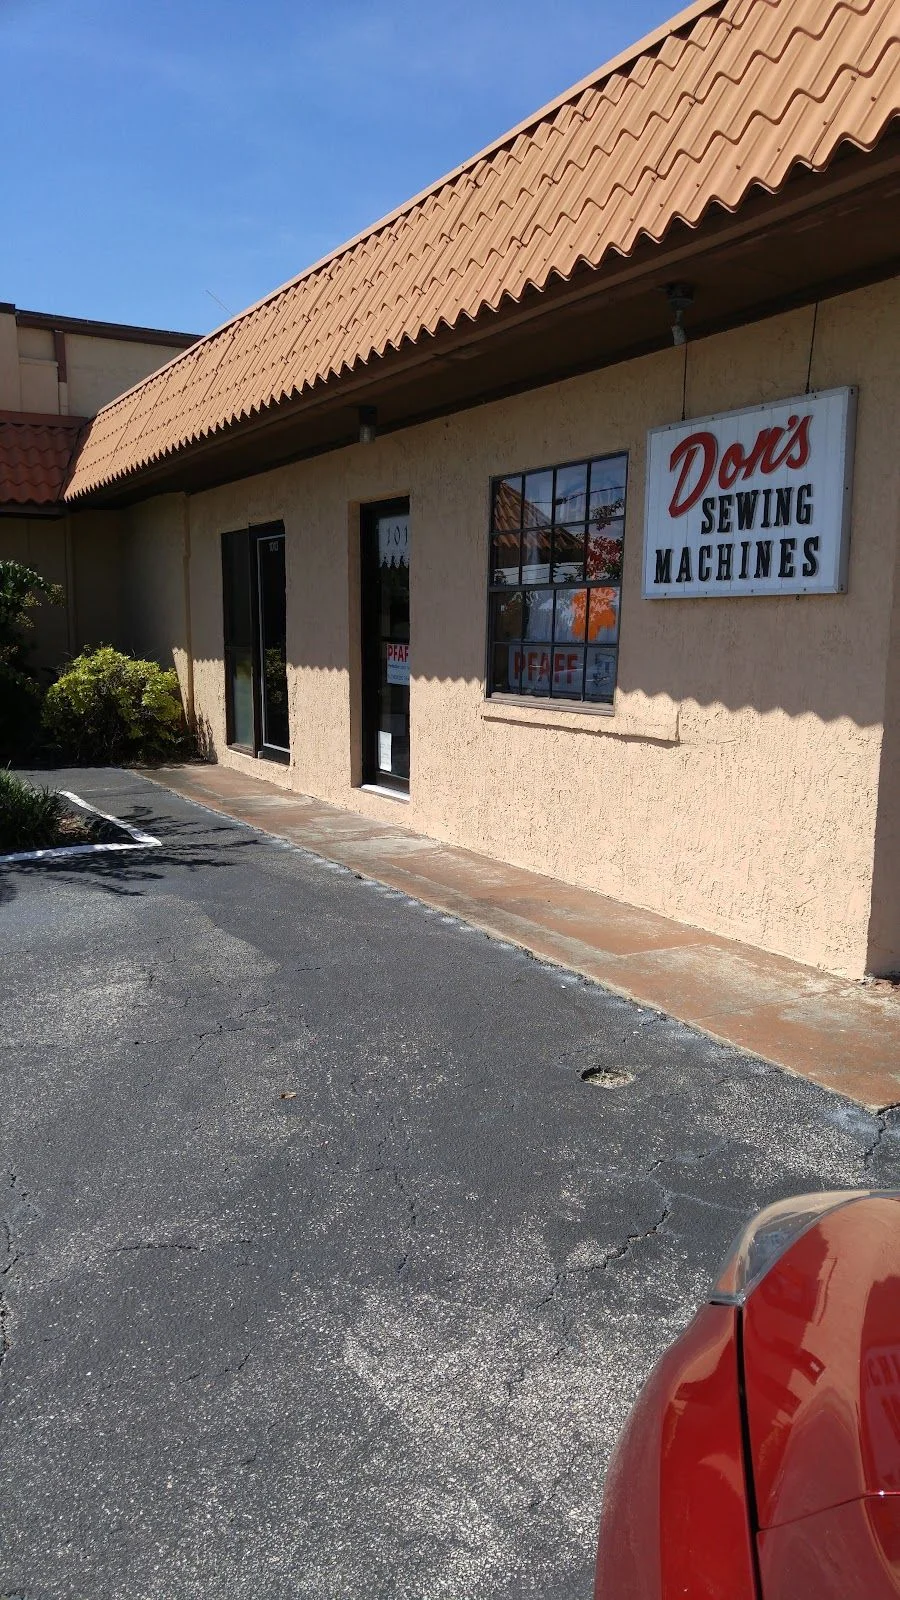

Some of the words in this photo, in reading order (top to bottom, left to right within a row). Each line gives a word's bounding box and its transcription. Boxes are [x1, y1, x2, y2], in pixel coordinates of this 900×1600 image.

[668, 415, 813, 518] Don's
[701, 483, 813, 535] SEWING
[654, 536, 820, 584] MACHINES
[514, 652, 578, 684] PFAFF
